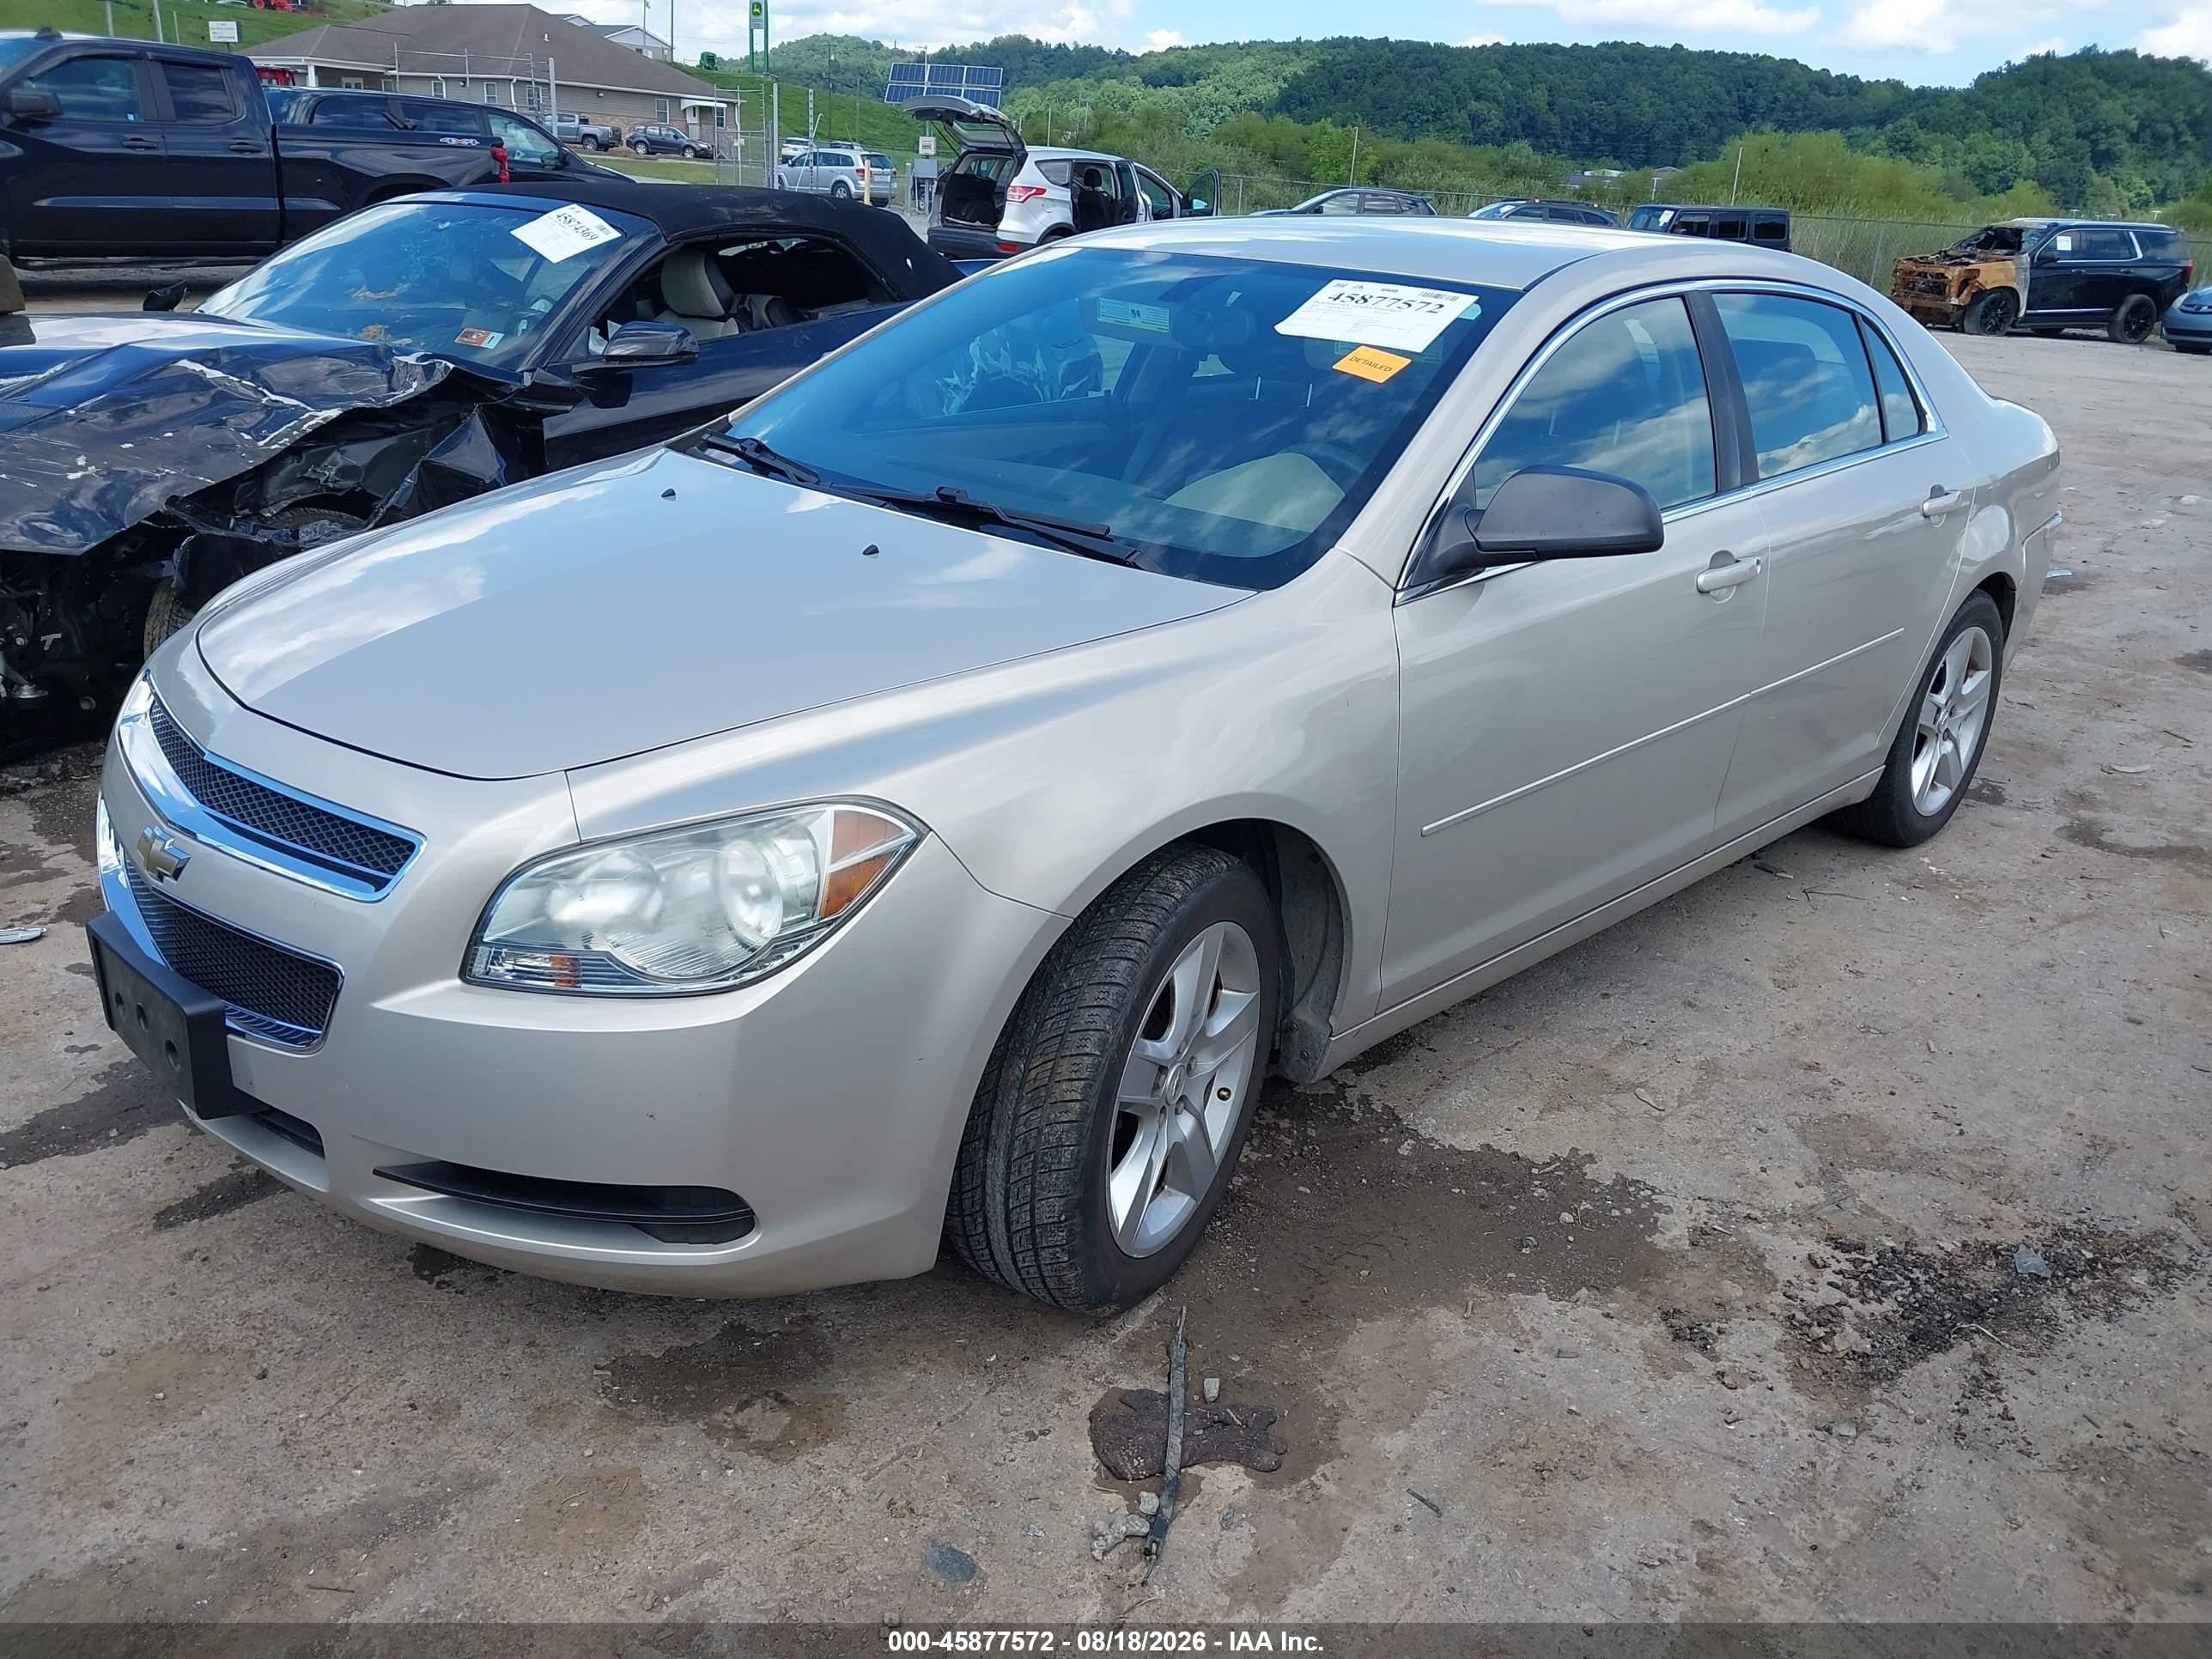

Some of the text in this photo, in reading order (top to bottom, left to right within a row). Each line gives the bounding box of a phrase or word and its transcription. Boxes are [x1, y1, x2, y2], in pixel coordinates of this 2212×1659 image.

[556, 212, 599, 240] 45874369
[1328, 292, 1445, 314] 45877572
[1348, 355, 1393, 373] DETAILED
